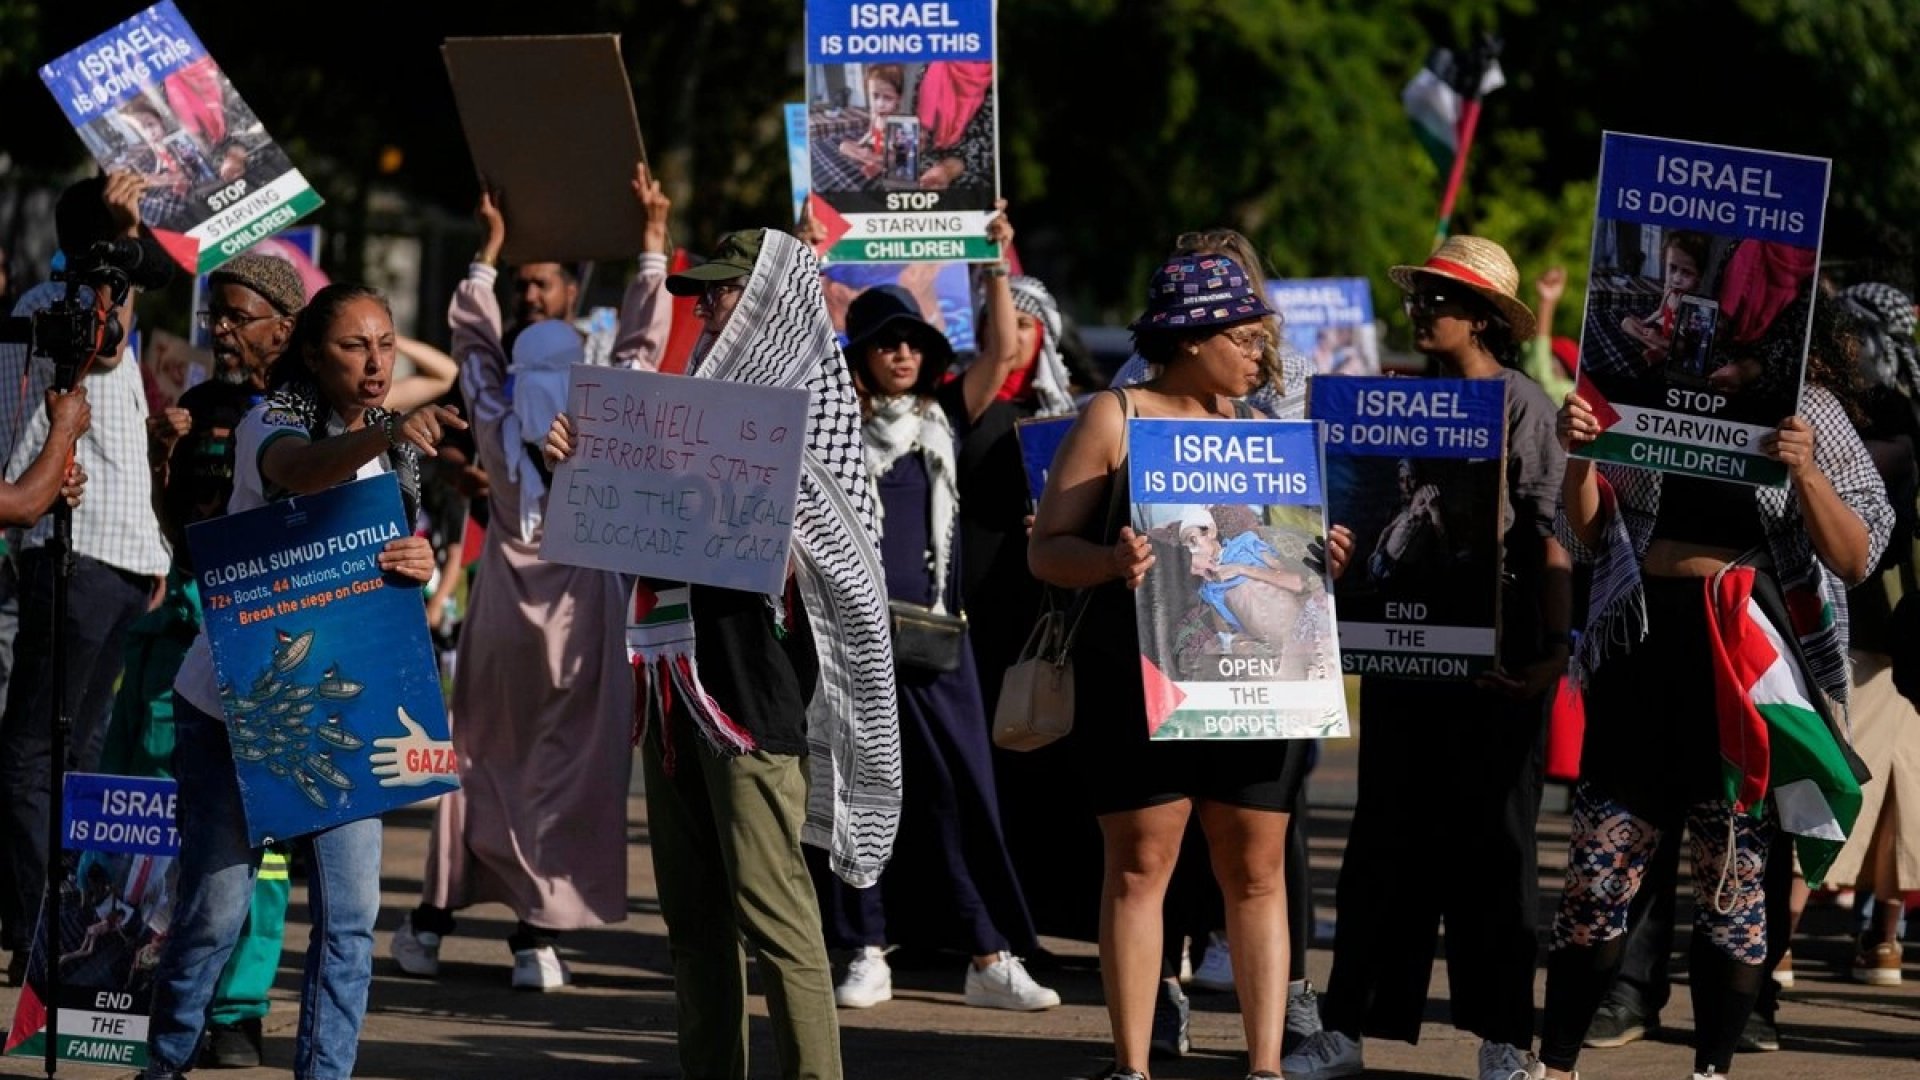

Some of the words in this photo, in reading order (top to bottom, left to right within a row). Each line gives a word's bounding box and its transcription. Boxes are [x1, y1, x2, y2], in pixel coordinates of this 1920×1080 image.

[851, 2, 960, 29] ISRAEL
[78, 25, 162, 81] ISRAEL
[820, 35, 843, 55] IS
[848, 34, 923, 54] DOING
[927, 32, 981, 53] THIS
[72, 92, 93, 115] IS
[92, 61, 150, 104] DOING
[148, 38, 191, 71] THIS
[1657, 154, 1782, 199] ISRAEL
[208, 178, 246, 211] STOP
[887, 192, 940, 211] STOP
[207, 188, 280, 237] STARVING
[866, 217, 962, 233] STARVING
[1617, 187, 1641, 211] IS
[1649, 191, 1736, 224] DOING
[1744, 204, 1804, 233] THIS
[221, 204, 297, 255] CHILDREN
[864, 240, 966, 258] CHILDREN
[576, 383, 709, 446] ISRAHELL
[1356, 389, 1468, 419] ISRAEL
[1666, 388, 1727, 414] STOP
[1325, 423, 1345, 444] IS
[1352, 424, 1428, 446] DOING
[1434, 426, 1489, 448] THIS
[1635, 413, 1749, 447] STARVING
[578, 434, 697, 472] TERRORIST
[706, 455, 779, 485] STATE
[1174, 434, 1284, 464] ISRAEL
[1631, 442, 1747, 478] CHILDREN
[1144, 471, 1166, 492] IS
[1172, 471, 1248, 493] DOING
[1252, 472, 1307, 494] THIS
[567, 468, 620, 510] END
[633, 490, 697, 522] THE
[711, 494, 790, 529] ILLEGAL
[574, 511, 688, 557] BLOCKADE
[703, 535, 733, 559] OF
[733, 537, 785, 563] GAZA
[204, 558, 268, 588] GLOBAL
[270, 541, 326, 571] SUMUD
[327, 520, 401, 555] FLOTILLA
[209, 594, 233, 610] 72+
[234, 584, 272, 605] Boats,
[272, 578, 289, 594] 44
[291, 565, 341, 589] Nations,
[341, 558, 366, 575] One
[239, 604, 276, 625] Break
[277, 598, 299, 616] the
[300, 592, 333, 613] siege
[336, 587, 351, 599] on
[352, 577, 385, 595] Gaza
[1385, 602, 1428, 620] END
[1385, 629, 1426, 647] THE
[1218, 657, 1275, 677] OPEN
[1342, 653, 1469, 677] STARVATION
[1229, 687, 1270, 705] THE
[406, 748, 458, 774] GAZA
[102, 788, 178, 819] ISRAE
[69, 819, 89, 840] IS
[94, 821, 161, 846] DOING
[95, 991, 133, 1010] END
[91, 1016, 127, 1035] THE
[66, 1039, 135, 1062] FAMINE
